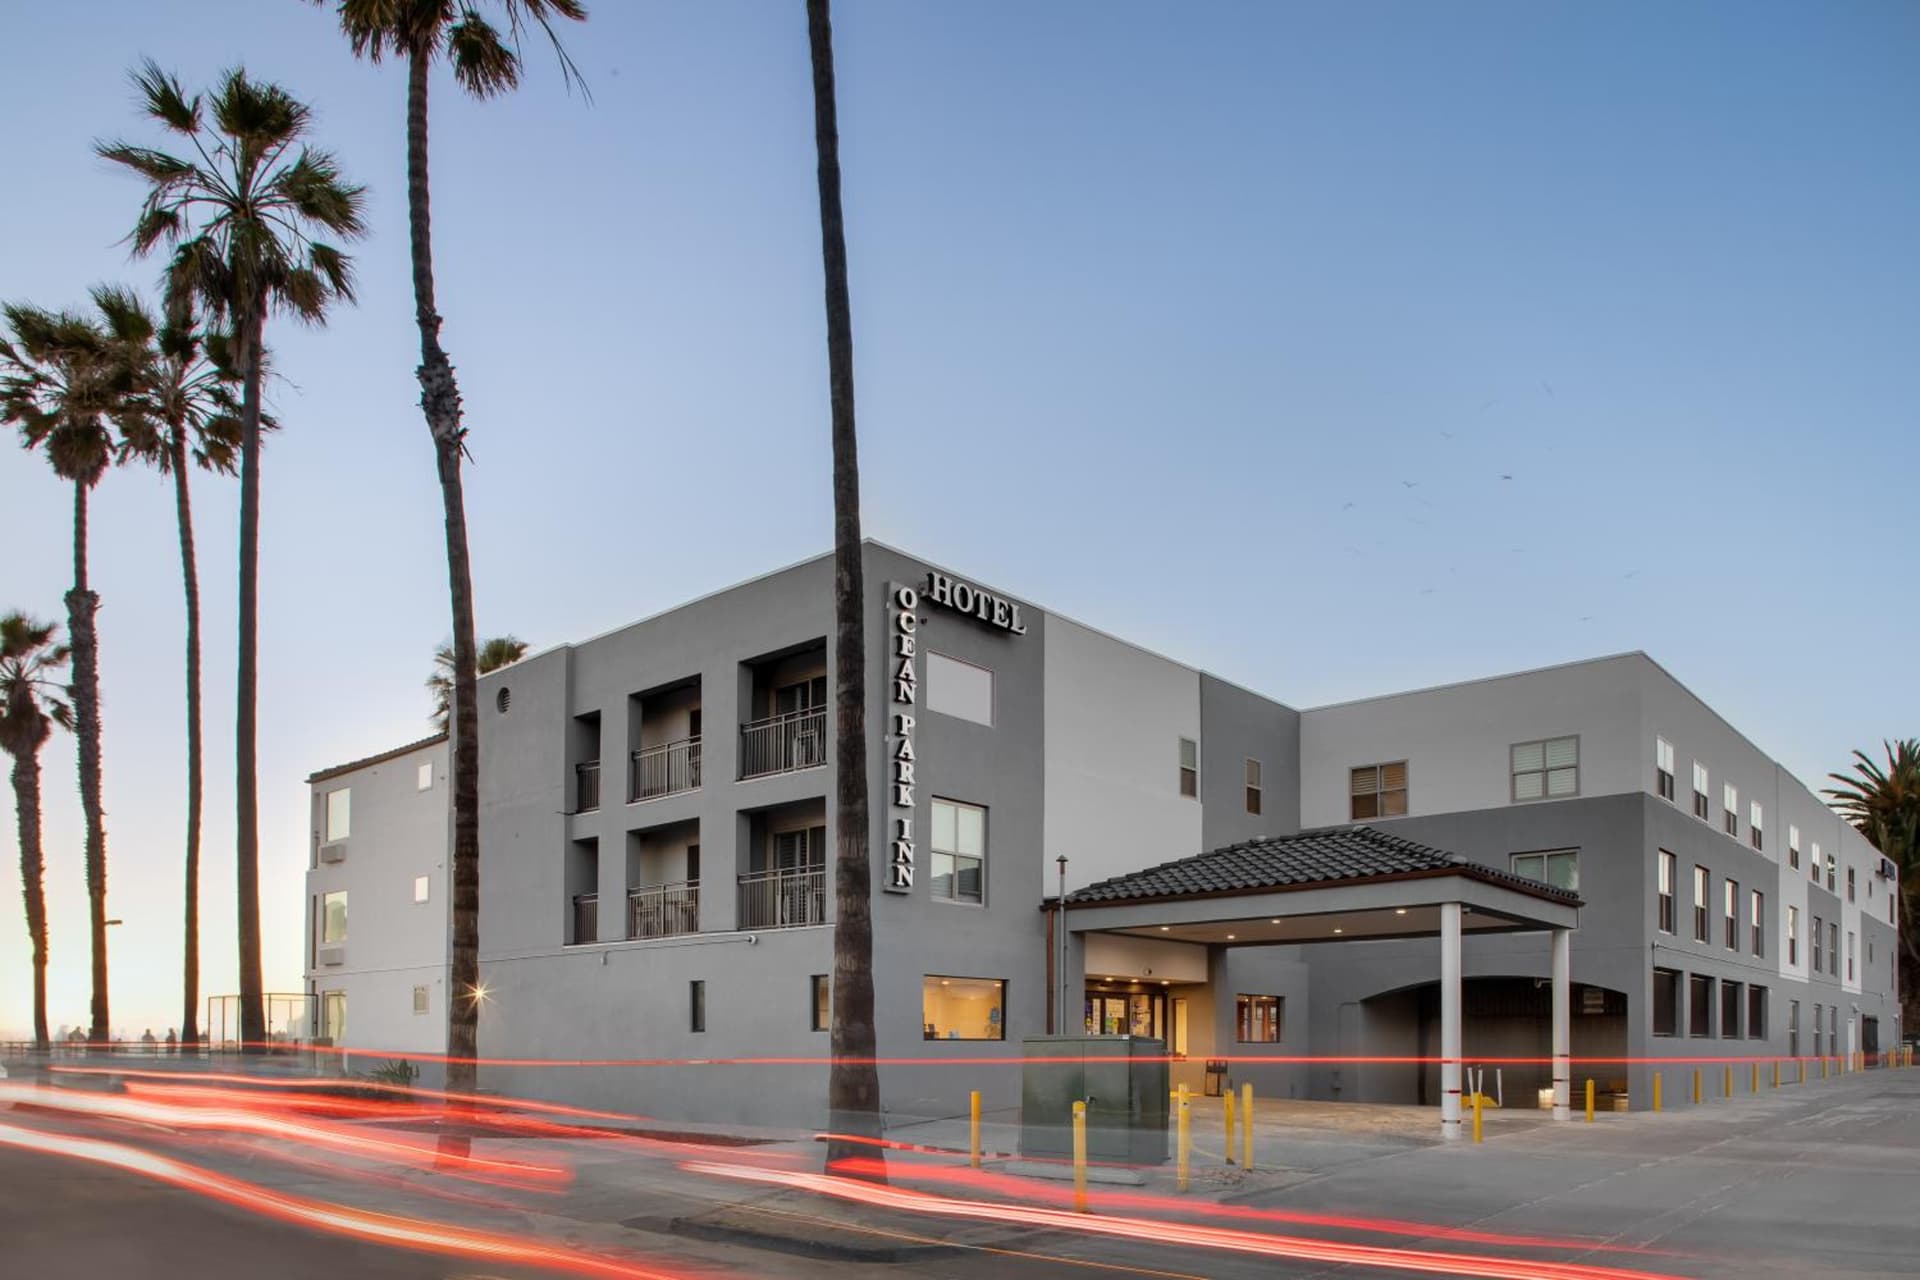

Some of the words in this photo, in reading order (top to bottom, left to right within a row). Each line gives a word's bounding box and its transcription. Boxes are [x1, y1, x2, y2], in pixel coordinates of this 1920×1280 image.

[929, 571, 1028, 634] HOTEL
[896, 586, 918, 704] OCEAN
[895, 713, 915, 807] PARK
[894, 817, 915, 888] INN
